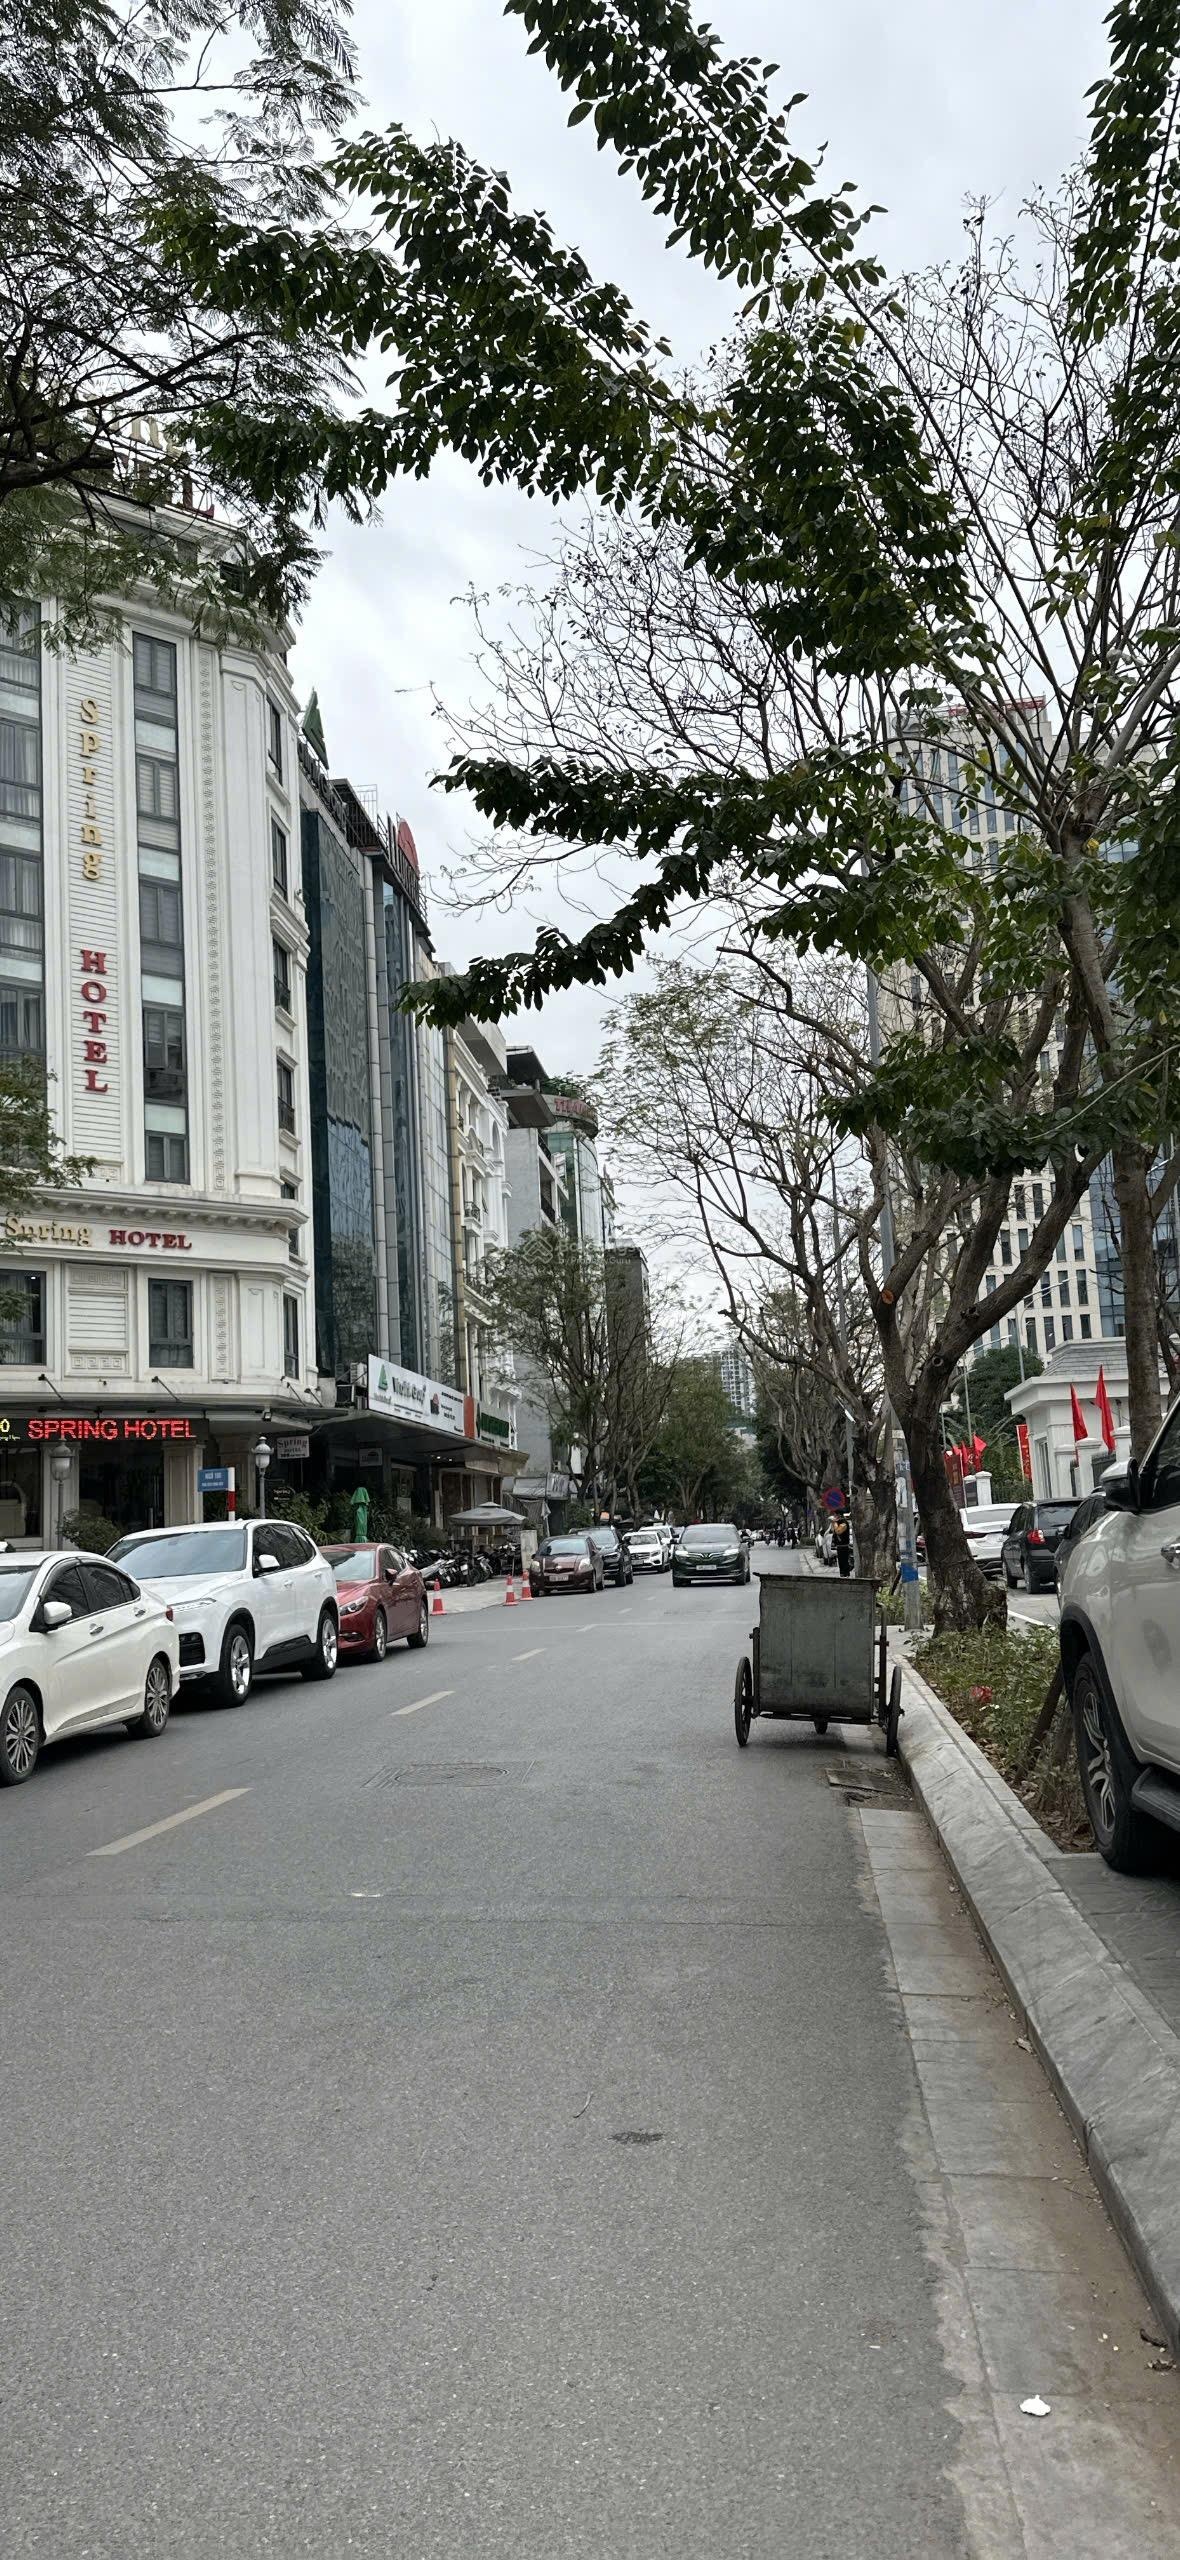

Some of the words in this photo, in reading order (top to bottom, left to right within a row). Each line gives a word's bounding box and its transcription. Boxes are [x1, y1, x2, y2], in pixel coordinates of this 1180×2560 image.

[80, 697, 103, 882] Spring
[80, 949, 108, 1093] HOTEL
[109, 1229, 192, 1249] HOTEL
[28, 1419, 118, 1440] SPRING
[124, 1418, 197, 1440] HOTEL
[277, 1438, 308, 1449] Spring
